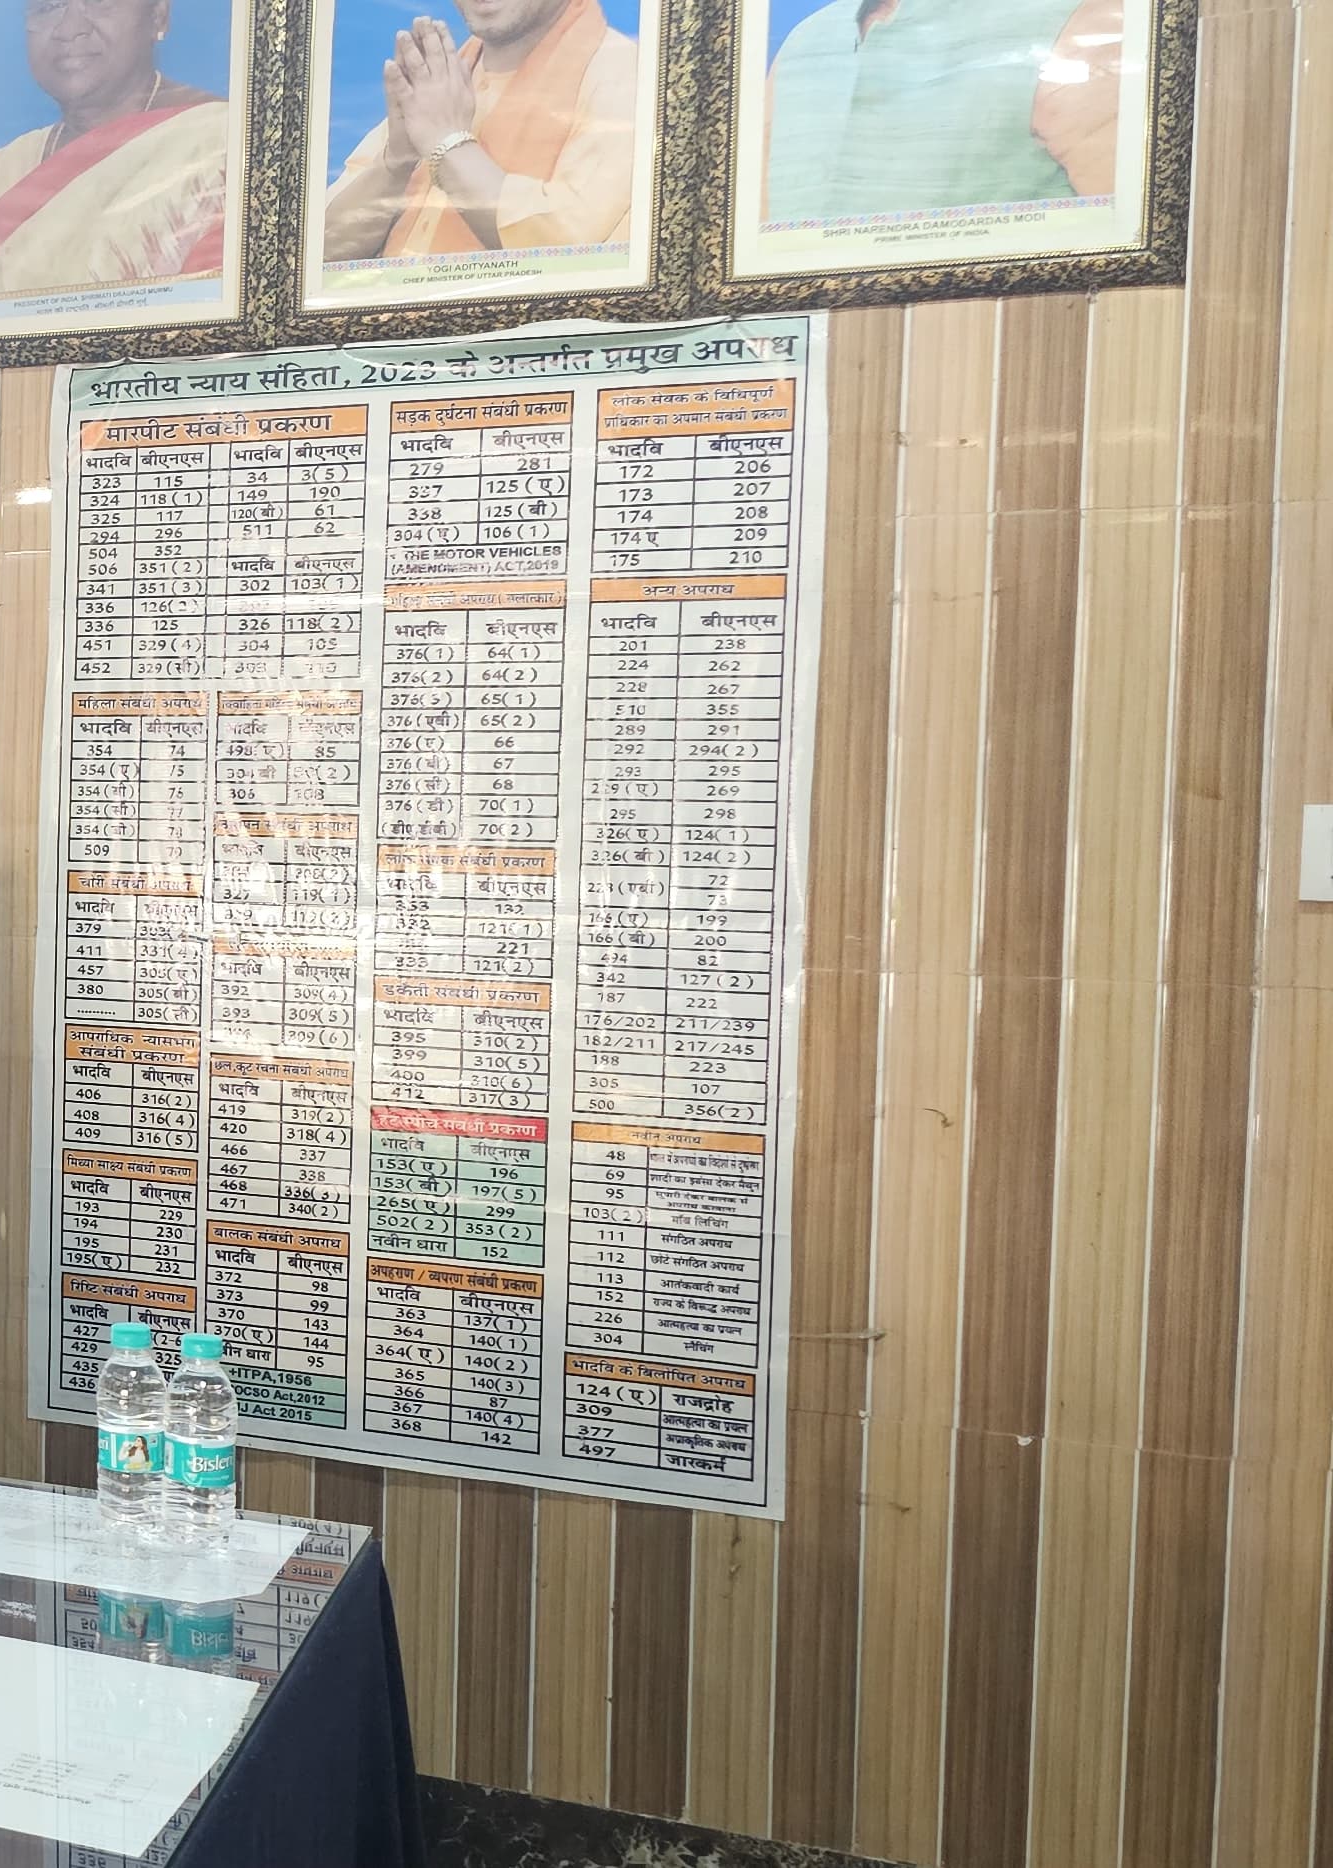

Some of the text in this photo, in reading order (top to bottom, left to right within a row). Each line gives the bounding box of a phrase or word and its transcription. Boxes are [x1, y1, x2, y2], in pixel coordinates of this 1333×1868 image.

[854, 223, 920, 236] NARENDRA
[1013, 212, 1046, 223] MODI
[427, 261, 518, 273] YOGI ADITYANATH
[427, 274, 462, 283] MINISTER
[477, 271, 503, 279] UTTAR
[504, 269, 542, 278] PRADESH
[90, 335, 799, 400] भारतीय न्याय संहिता, 2023 के अन्तर्गत प्रमुख अपराध
[396, 400, 568, 427] सड़क दुर्घटना संबंधी प्रकरण
[652, 414, 668, 426] का
[105, 418, 179, 442] मारपीट
[256, 414, 332, 435] प्रकरण
[85, 452, 133, 469] भादवि
[409, 463, 444, 476] 279
[618, 465, 654, 478] 172
[92, 476, 121, 490] 323
[308, 486, 341, 499] 190
[156, 511, 183, 521] 117
[616, 509, 653, 524] 174
[242, 524, 272, 537] 511
[433, 548, 485, 560] MOTOR
[489, 546, 562, 558] VEHICLES
[609, 553, 640, 567] 175
[87, 564, 118, 575] 506
[642, 584, 735, 597] अन्य अपराध
[85, 621, 114, 632] 336
[82, 640, 112, 651] 451
[619, 640, 647, 651] 201
[707, 683, 740, 695] 267
[613, 743, 645, 754] 292
[493, 758, 514, 769] 67
[703, 808, 736, 819] 298
[84, 845, 110, 857] 509
[496, 942, 529, 955] 221
[77, 985, 104, 995] 380
[486, 990, 541, 1003] प्रकरण
[686, 997, 718, 1009] 222
[69, 1030, 134, 1045] आपराधिक
[674, 1040, 754, 1055] 217/245
[78, 1045, 185, 1064] संबंधी प्रकरण
[391, 1049, 427, 1061] 399
[691, 1084, 720, 1095] 107
[73, 1110, 100, 1121] 408
[218, 1104, 246, 1115] 419
[67, 1156, 191, 1178] मिथ्या साक्ष्य संबंधी प्रकरण
[219, 1164, 247, 1175] 467
[490, 1167, 519, 1180] 196
[605, 1188, 625, 1199] 95
[219, 1198, 247, 1210] 471
[159, 1210, 183, 1222] 229
[212, 1227, 342, 1249] बालक संबंधी अपराध
[372, 1233, 448, 1253] नवीन धारा
[661, 1233, 733, 1249] संगठित अपराध
[153, 1245, 178, 1257] 231
[214, 1270, 242, 1283] 372
[597, 1273, 624, 1285] 113
[70, 1279, 187, 1305] रिष्टि संबंधी अपराध
[660, 1278, 714, 1293] आतंकवादी
[376, 1285, 421, 1302] भादवि
[310, 1299, 330, 1313] 99
[72, 1360, 99, 1373] 435
[306, 1355, 325, 1368] 95
[394, 1368, 425, 1382] 365
[572, 1360, 614, 1374] भादवि
[618, 1363, 633, 1377] के
[700, 1375, 746, 1390] अपराध
[231, 1384, 326, 1407] OCSO Act,2012
[672, 1393, 735, 1414] राजद्रोह
[252, 1403, 312, 1422] Act 2015
[391, 1418, 422, 1432] 368
[579, 1444, 616, 1458] 497
